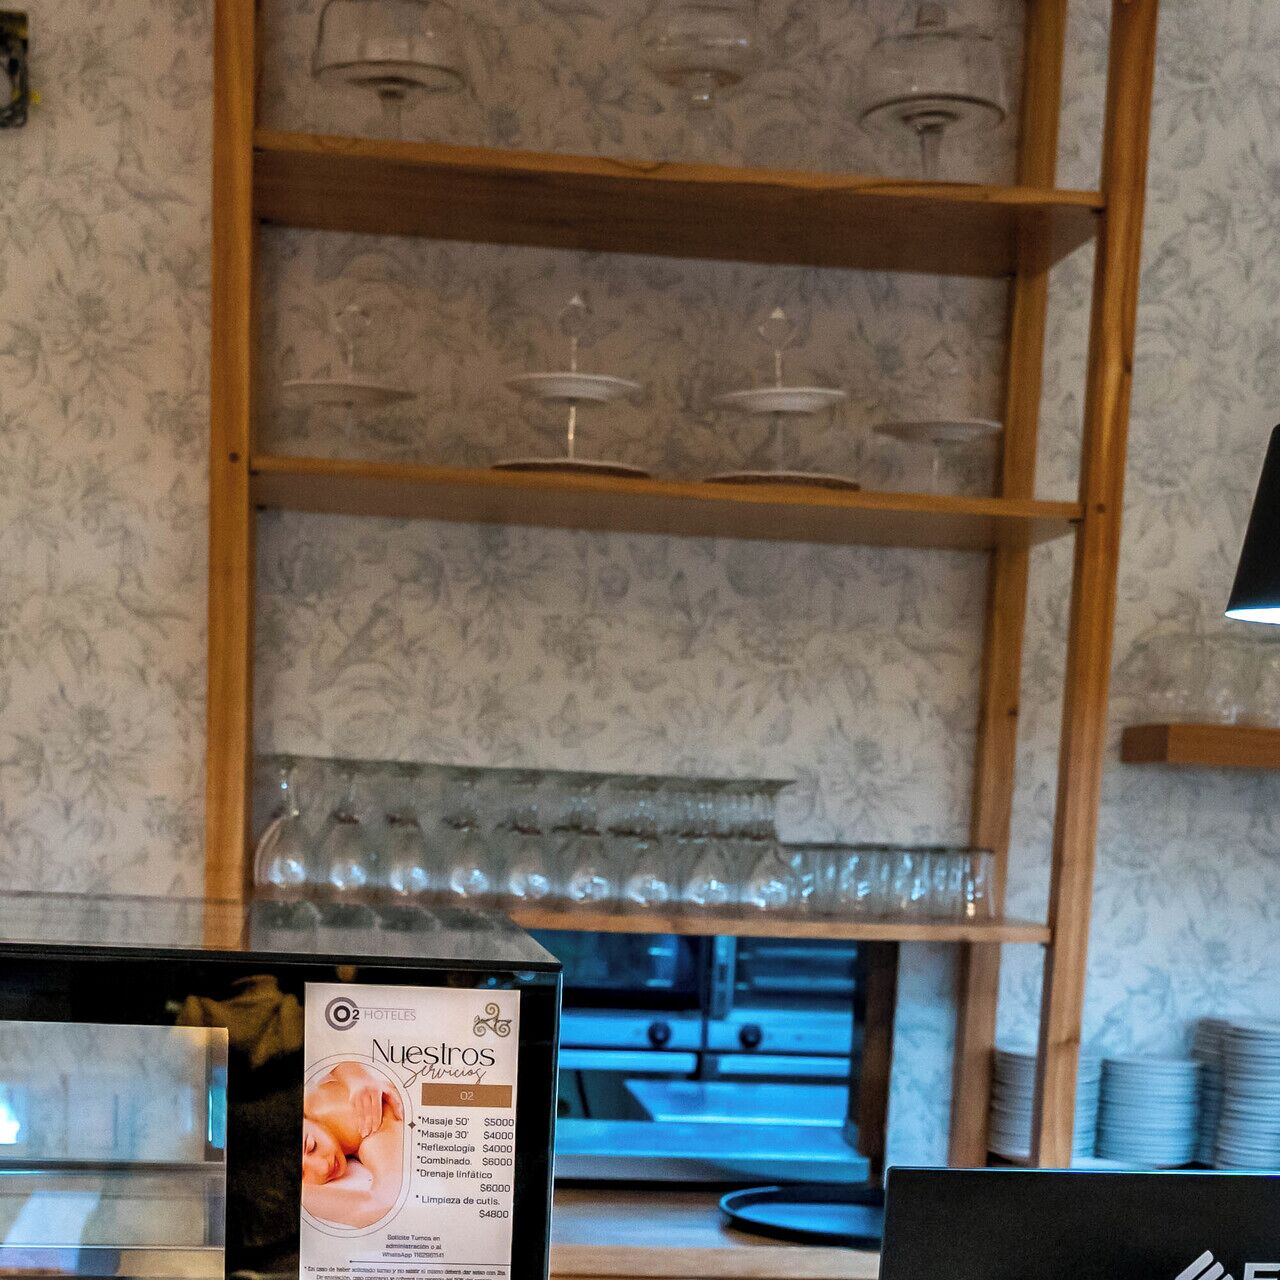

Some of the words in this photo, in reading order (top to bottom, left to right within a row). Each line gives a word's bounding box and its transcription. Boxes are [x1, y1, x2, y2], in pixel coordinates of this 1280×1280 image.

[364, 1010, 417, 1021] HOTELES
[372, 1038, 496, 1067] Nuestros
[402, 1056, 487, 1088] Servicios
[421, 1117, 453, 1126] Masaje
[484, 1118, 515, 1127] $5000
[421, 1130, 453, 1140] Masaje
[483, 1131, 514, 1140] $4000
[482, 1144, 513, 1153] $4000
[482, 1157, 513, 1166] $6000
[420, 1169, 455, 1179] Drenaje
[480, 1184, 511, 1193] $6000
[422, 1196, 461, 1205] Limpieza
[476, 1197, 500, 1205] cutis.
[479, 1209, 509, 1218] $4800
